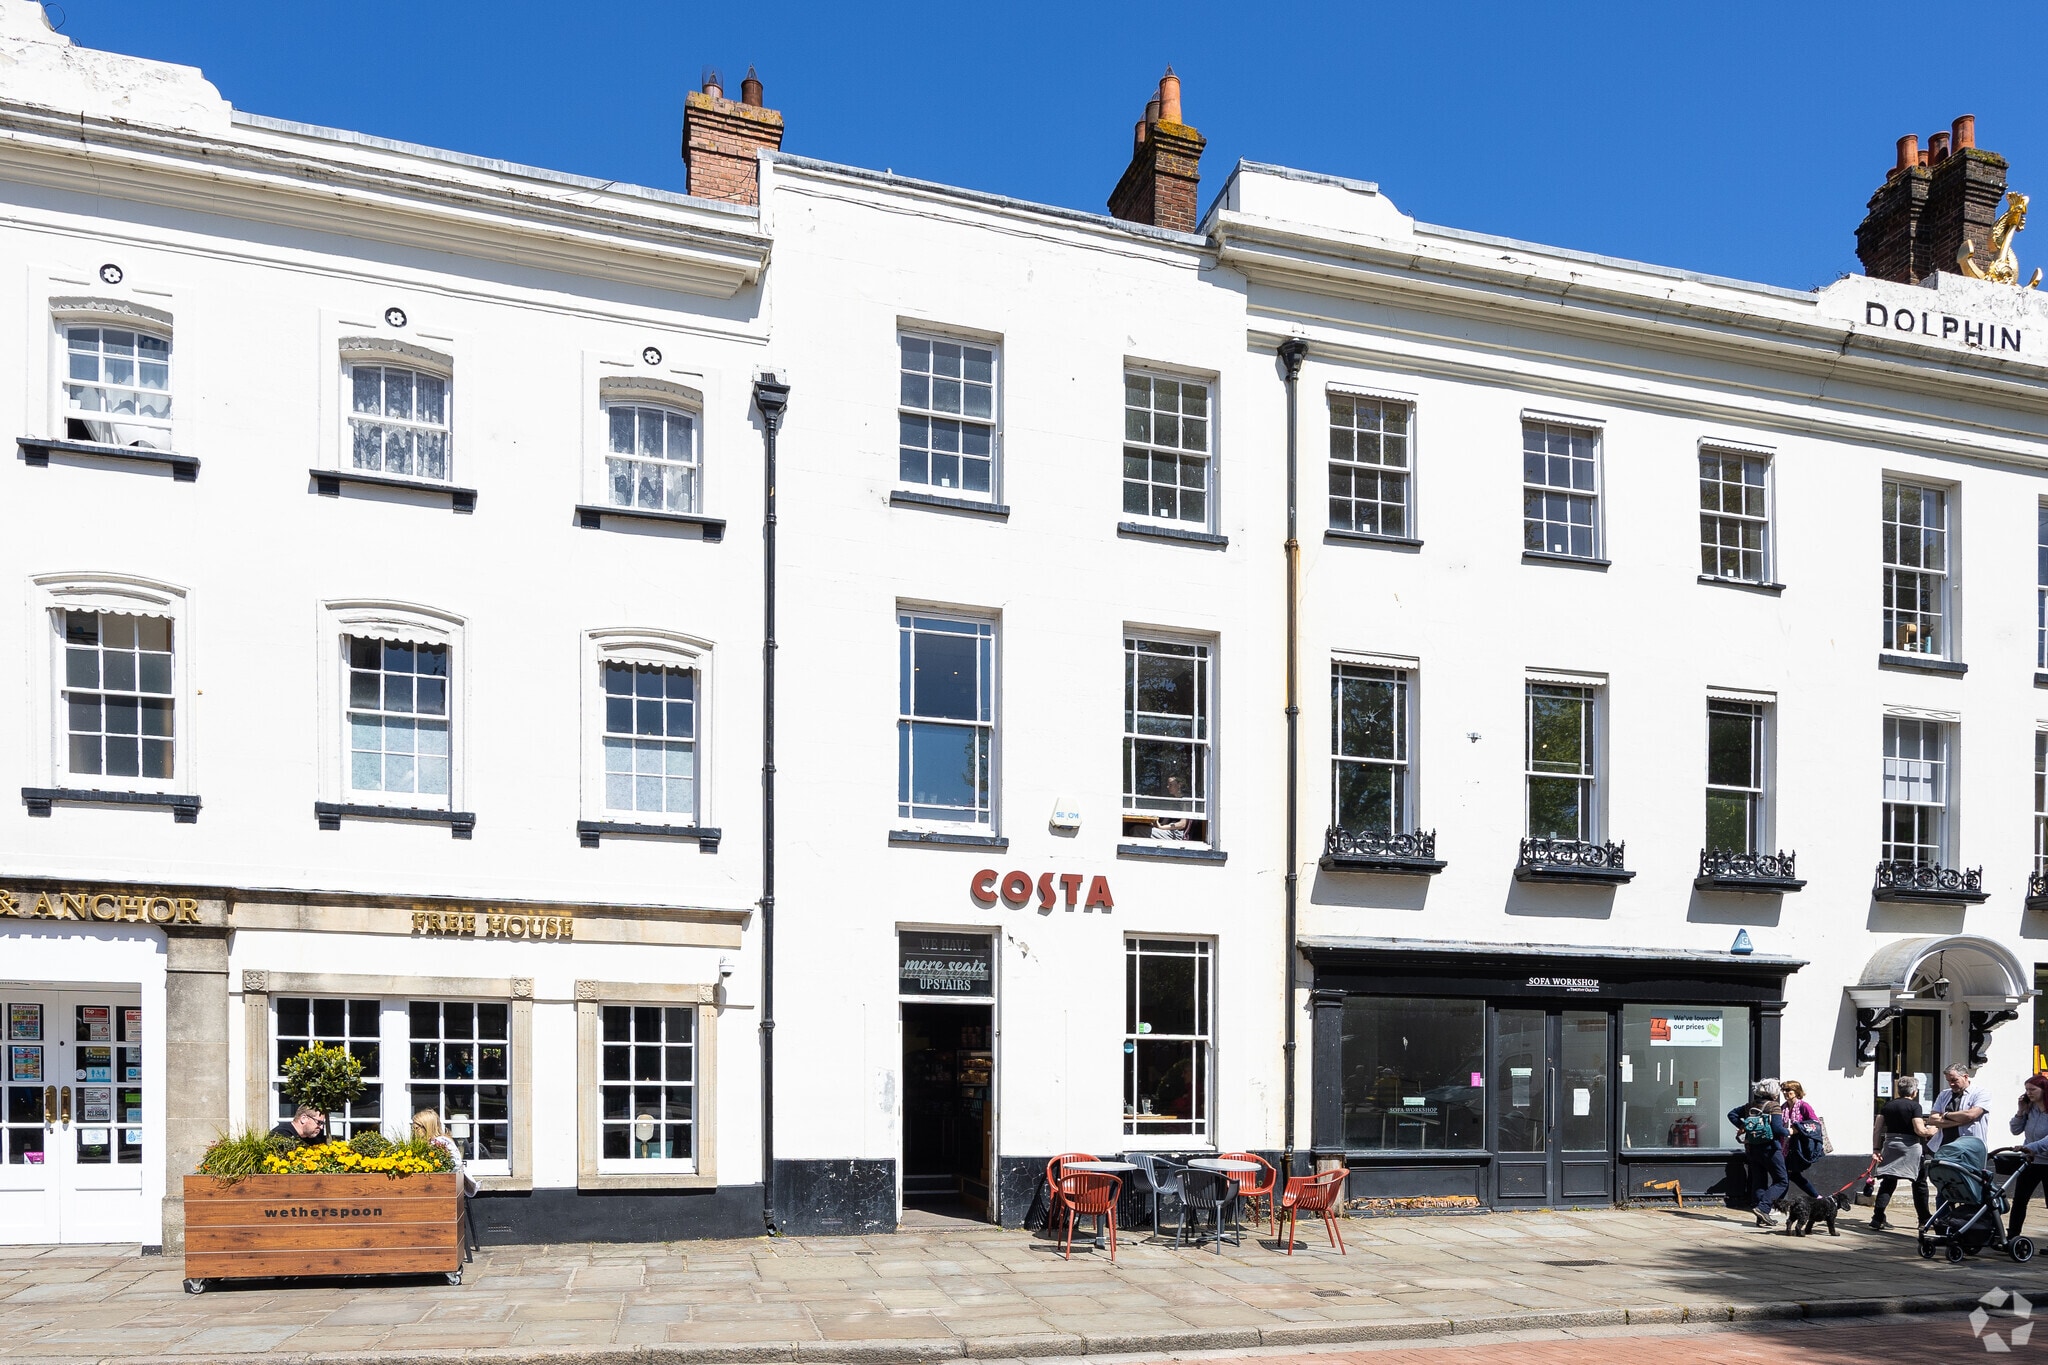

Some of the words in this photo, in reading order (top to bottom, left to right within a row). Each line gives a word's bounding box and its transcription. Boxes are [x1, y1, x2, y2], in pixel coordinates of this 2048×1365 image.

[1866, 301, 2021, 352] DOLPHIN
[971, 868, 1115, 910] COSTA
[0, 889, 19, 916] &
[31, 891, 202, 923] ANCHOR
[412, 912, 476, 931] FREE
[486, 914, 574, 936] HOUSE
[920, 938, 938, 951] WE
[941, 939, 971, 952] HAVE
[904, 959, 945, 971] more
[947, 959, 987, 973] seats
[920, 979, 971, 991] UPSTAIRS
[1528, 977, 1551, 985] SOFA
[1552, 977, 1599, 987] WORKSHOP
[1685, 1023, 1705, 1031] prices
[264, 1207, 383, 1218] wetherspoon
